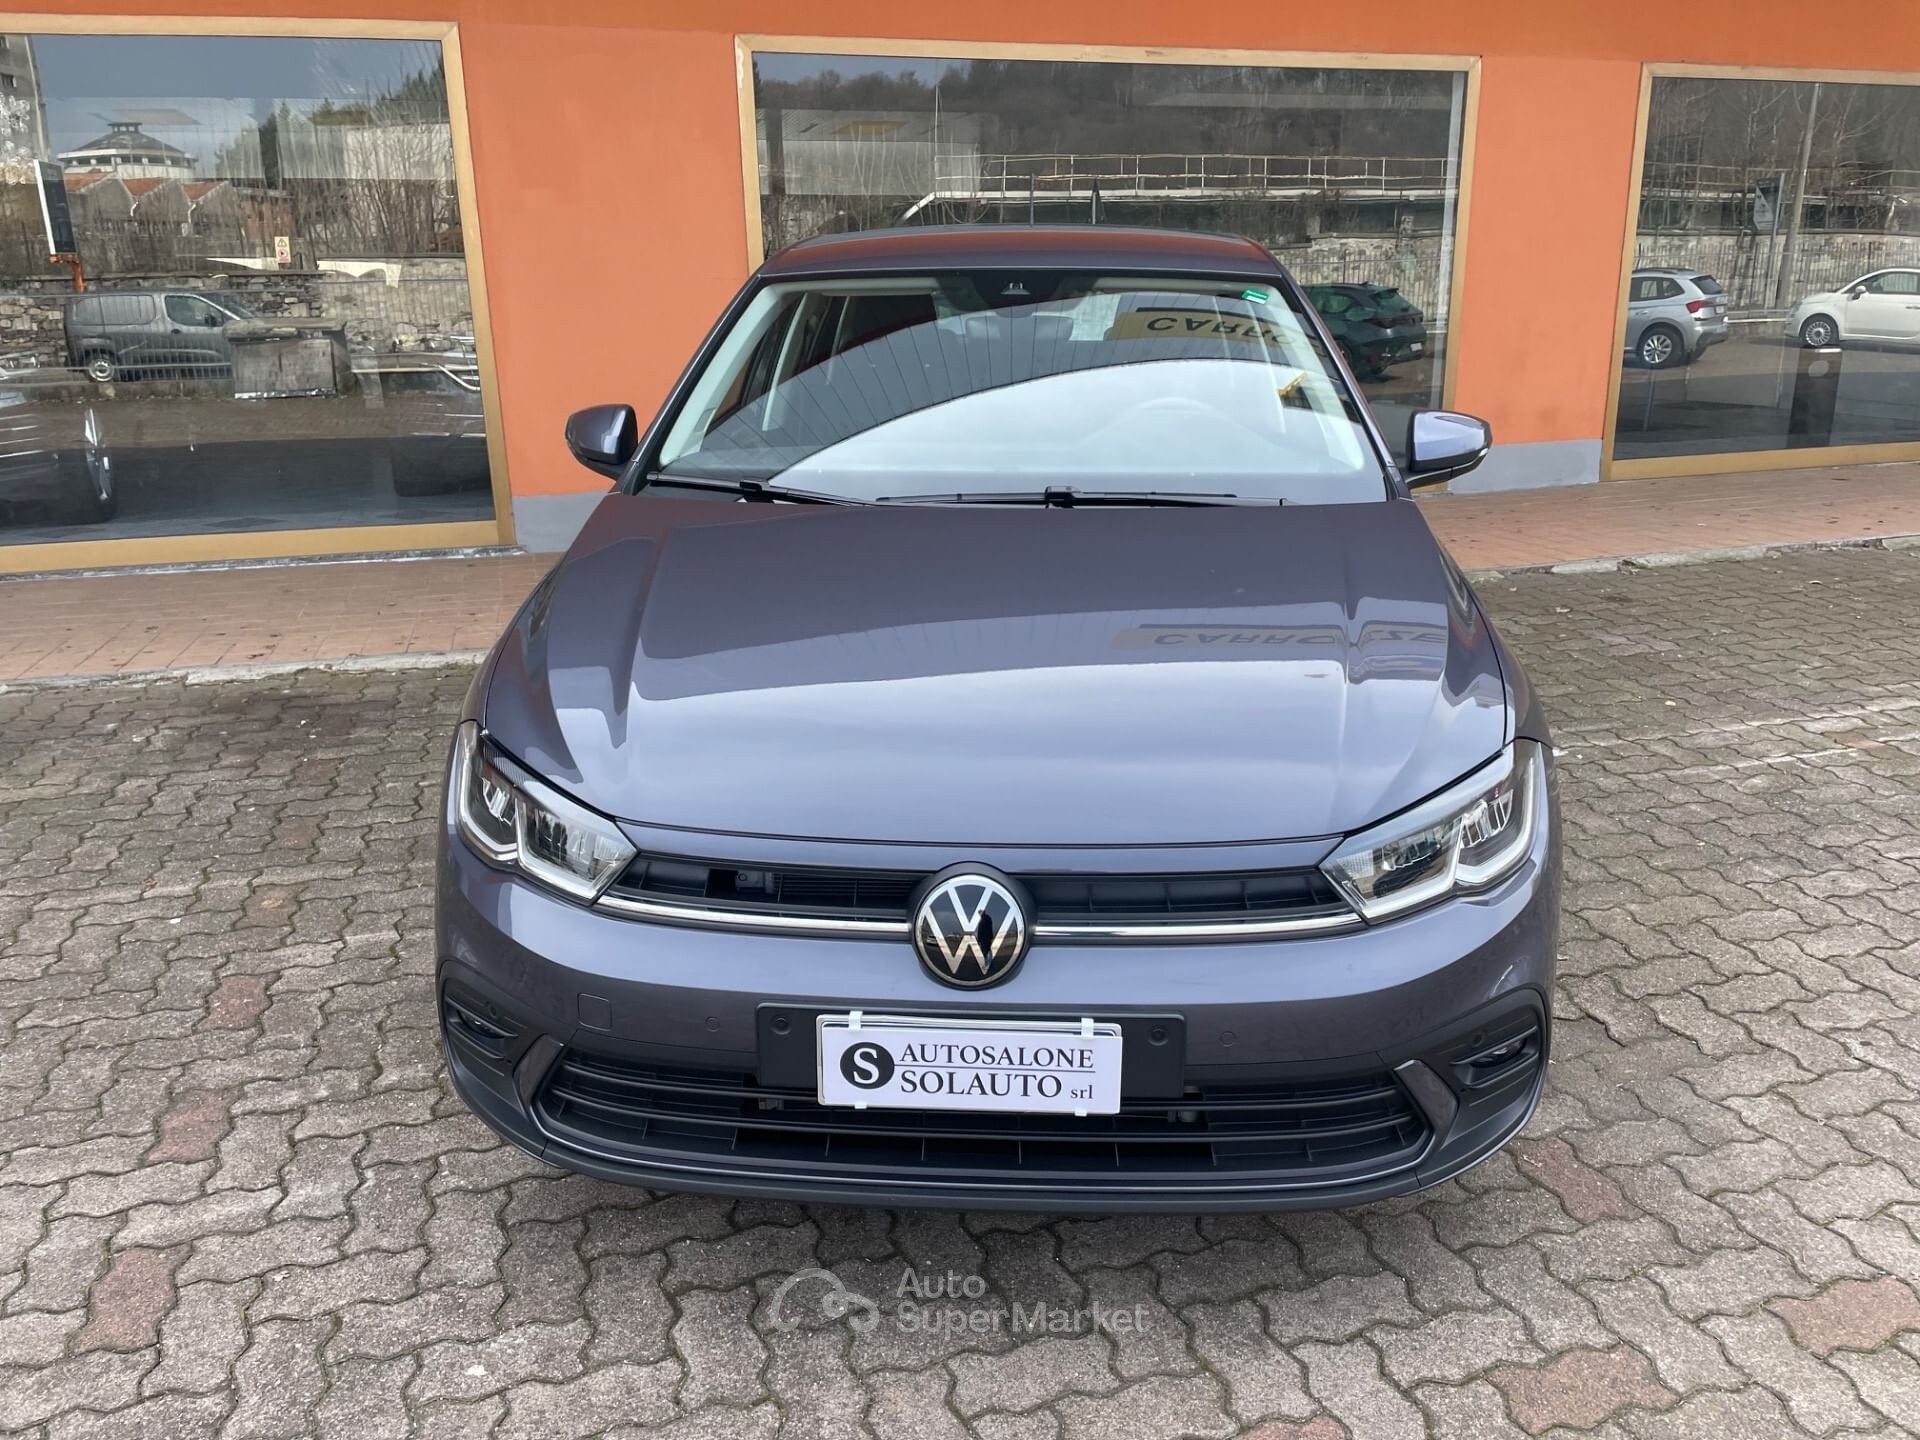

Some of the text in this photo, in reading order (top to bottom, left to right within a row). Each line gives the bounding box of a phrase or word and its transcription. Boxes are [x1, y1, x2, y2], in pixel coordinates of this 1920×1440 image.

[921, 880, 1018, 976] VW
[853, 1047, 880, 1085] S
[899, 1043, 1094, 1069] AUTOSALONE
[900, 1069, 1094, 1099] SOLAUTO srl
